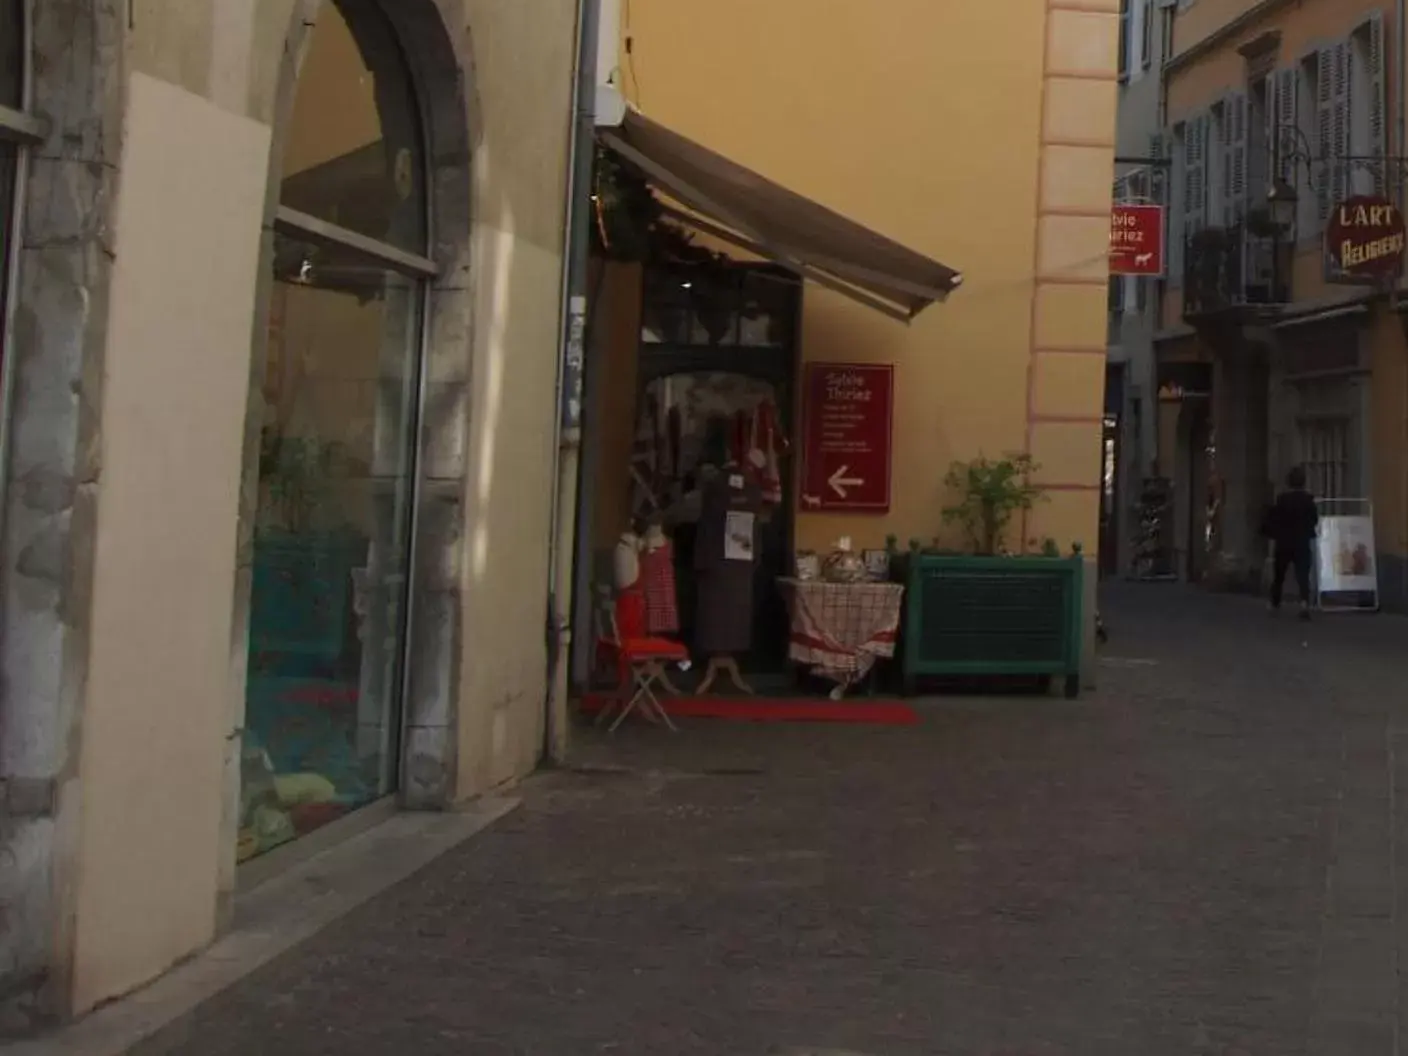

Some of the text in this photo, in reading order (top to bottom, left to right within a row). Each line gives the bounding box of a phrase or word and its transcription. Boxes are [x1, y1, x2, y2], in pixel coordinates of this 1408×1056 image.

[1112, 211, 1136, 227] lvie
[1339, 204, 1394, 226] L'ART
[1109, 227, 1144, 242] iriez
